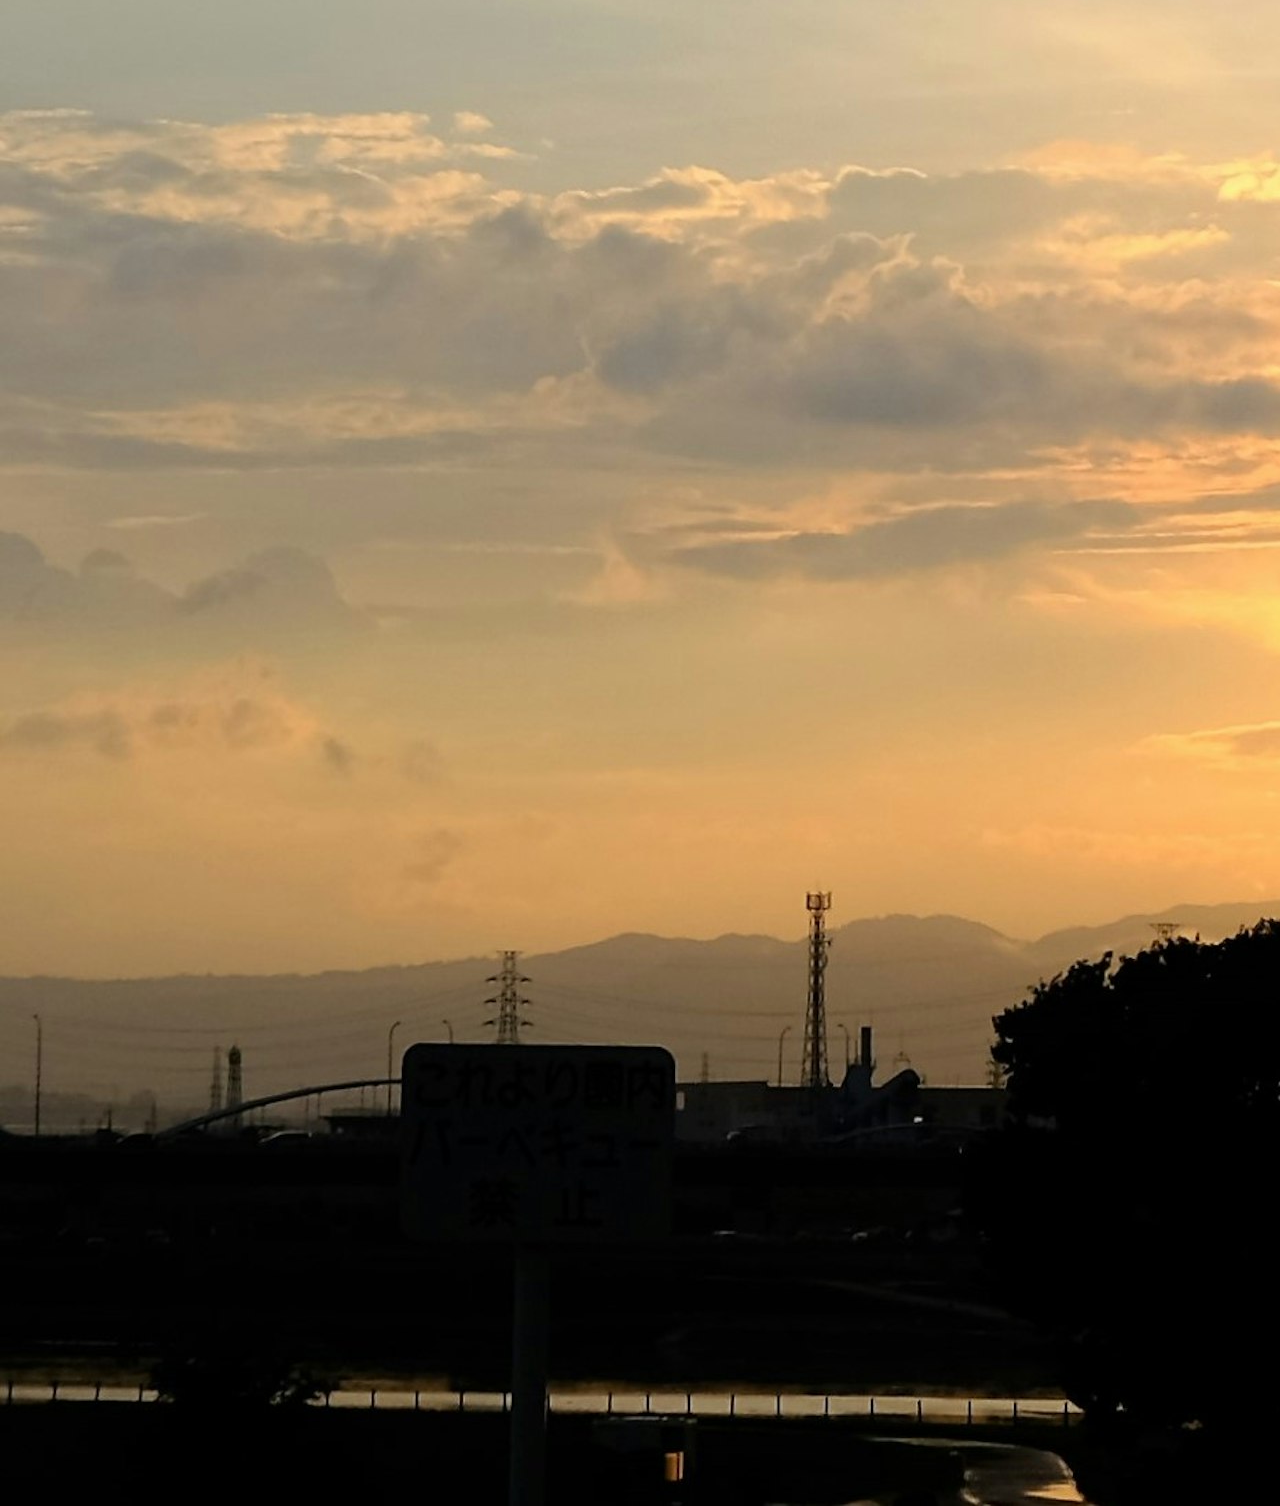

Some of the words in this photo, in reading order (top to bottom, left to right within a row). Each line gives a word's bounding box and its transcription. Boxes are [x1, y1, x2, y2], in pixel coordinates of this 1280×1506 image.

[408, 1118, 661, 1168] バーベキュー
